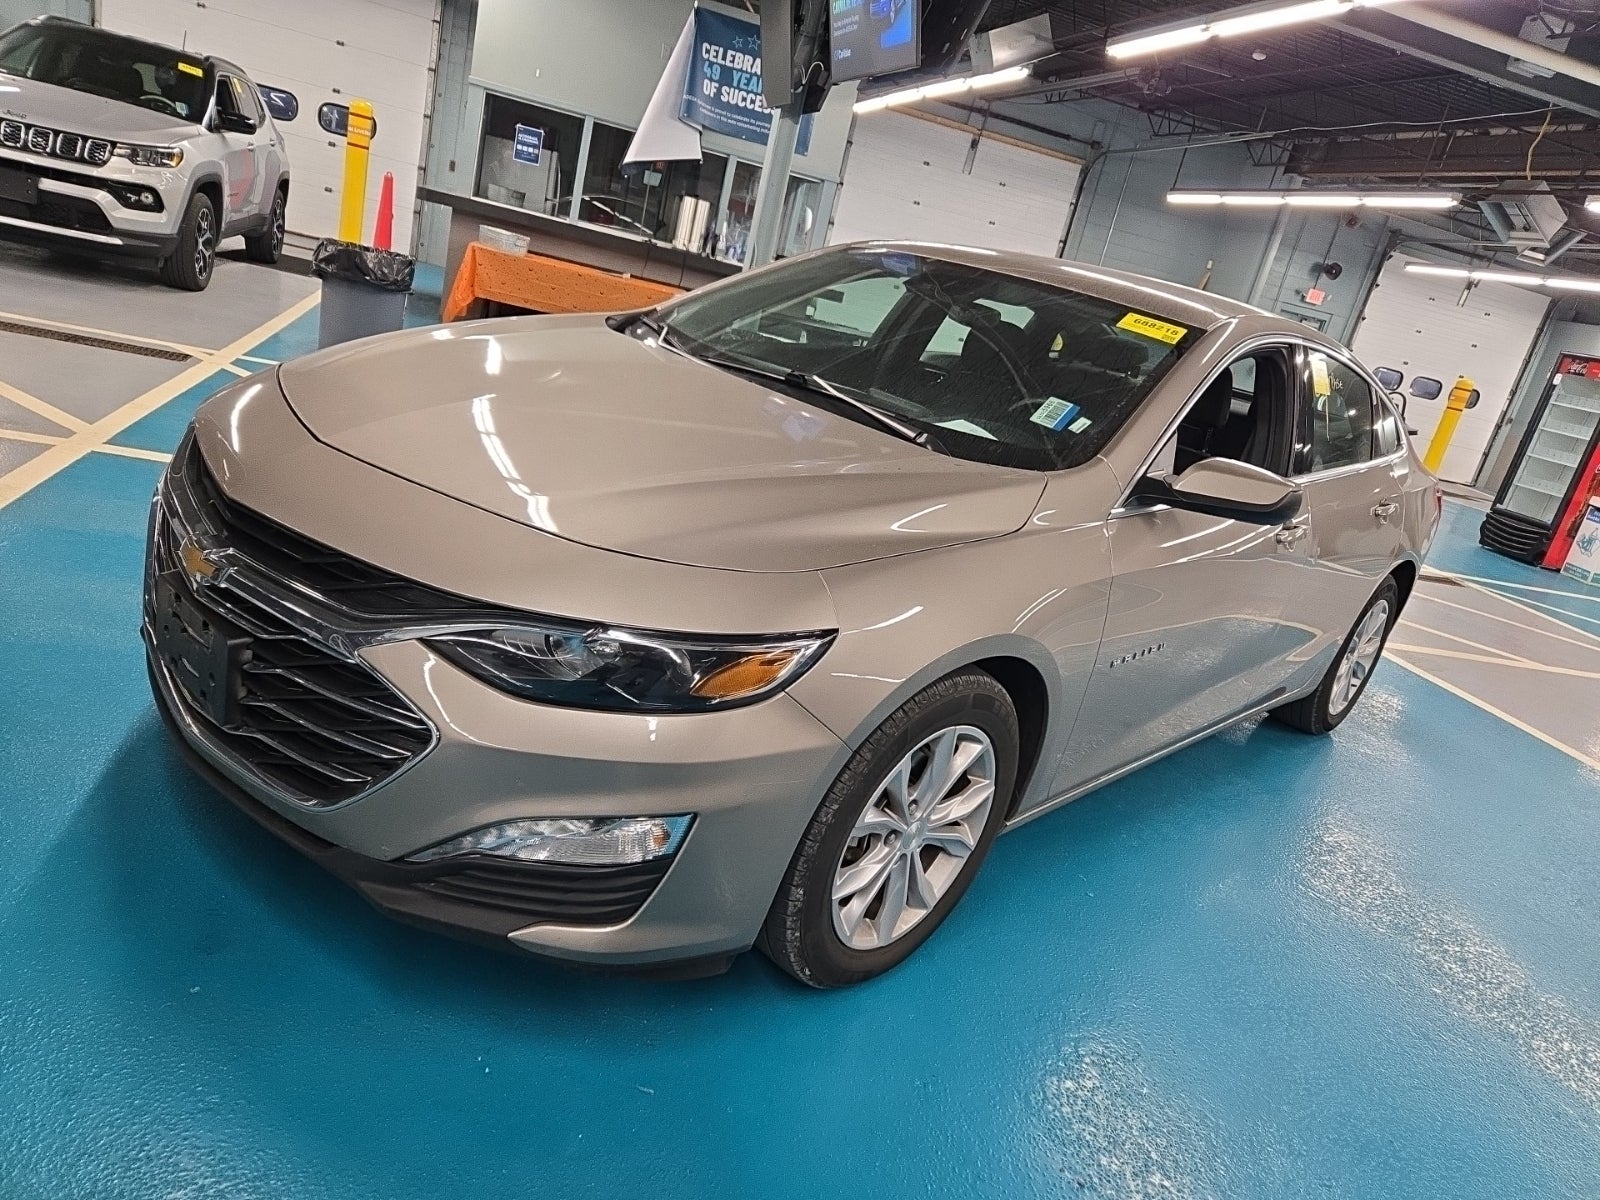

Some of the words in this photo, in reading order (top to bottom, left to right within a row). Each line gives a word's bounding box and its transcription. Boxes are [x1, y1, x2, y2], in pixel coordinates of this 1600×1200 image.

[702, 42, 762, 76] CELEBRA
[703, 61, 721, 81] 49
[703, 78, 719, 98] OF
[720, 86, 776, 114] SUCCE
